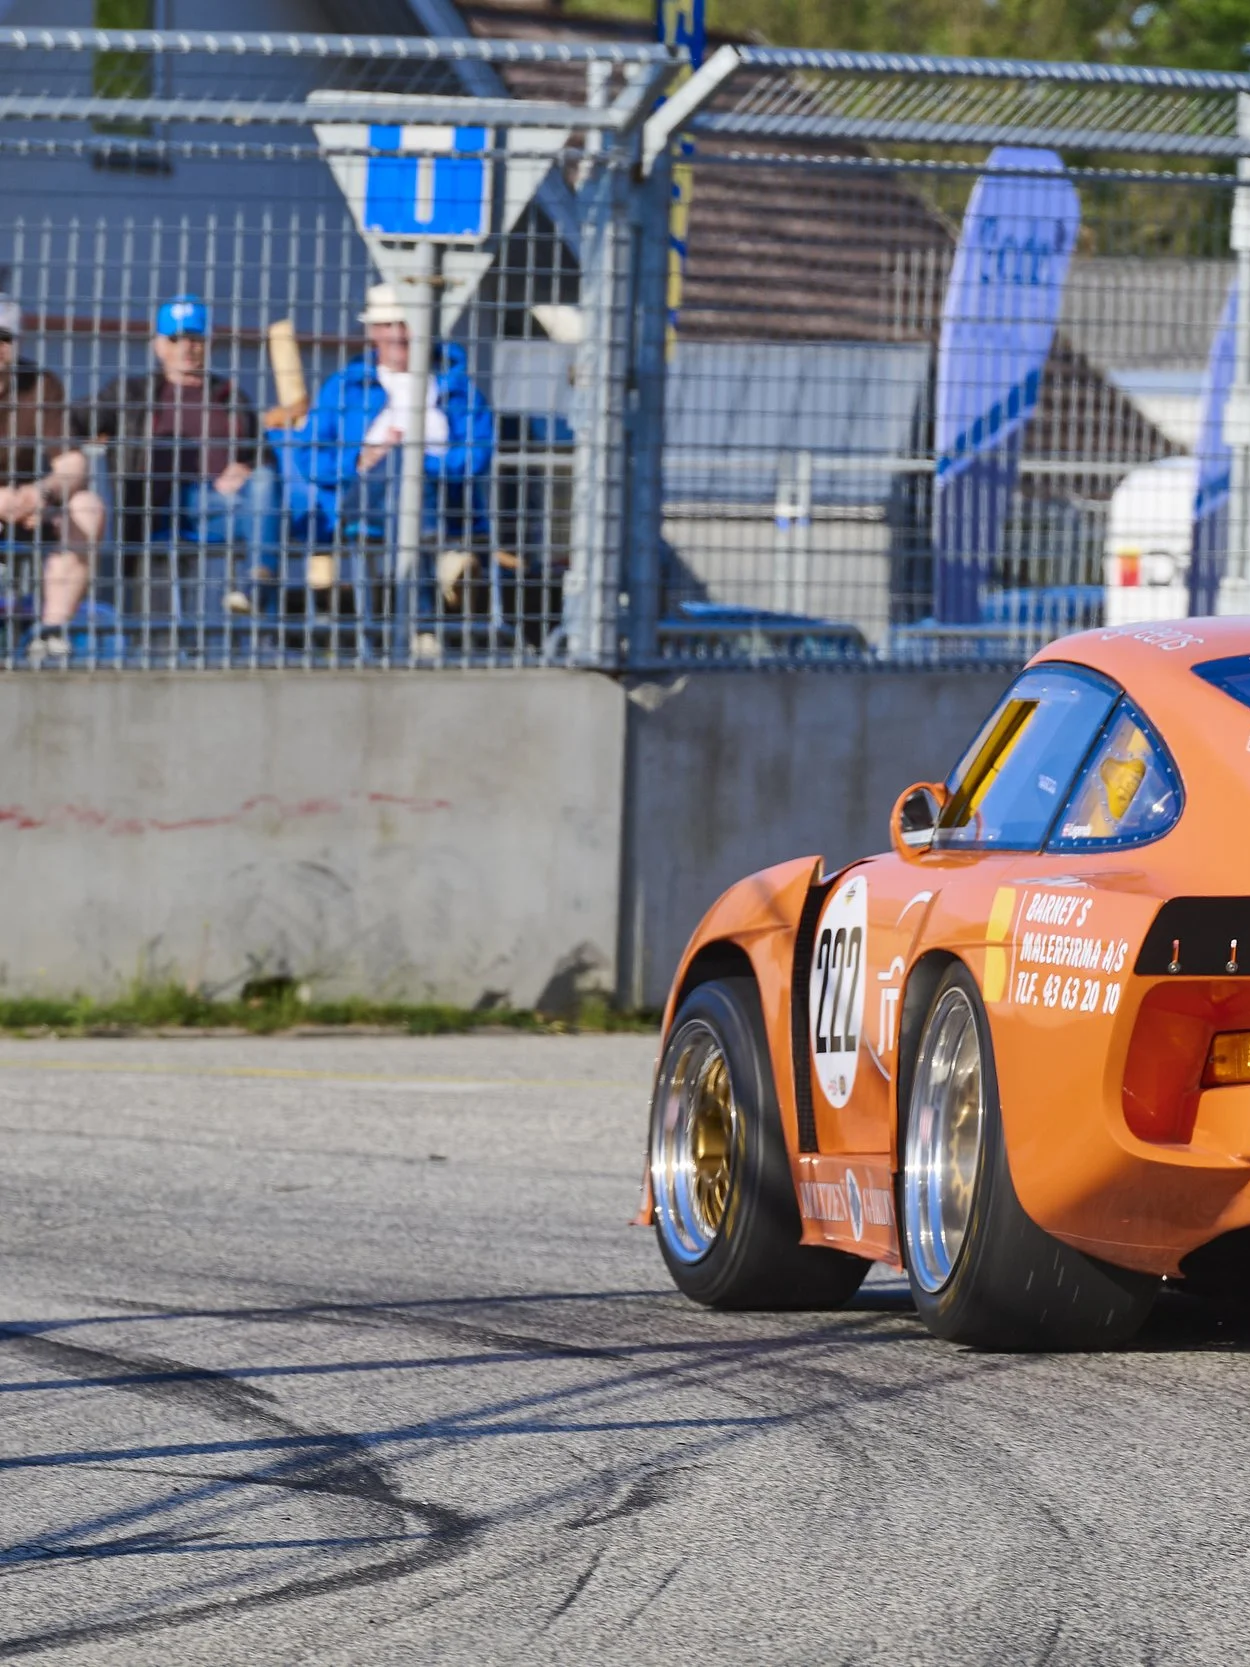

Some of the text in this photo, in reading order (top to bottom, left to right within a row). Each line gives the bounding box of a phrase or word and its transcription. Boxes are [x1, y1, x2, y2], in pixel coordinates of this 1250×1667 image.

[1020, 931, 1129, 975] MALERFIRMA A/S
[815, 926, 863, 1054] 222
[1042, 973, 1062, 1008] 43
[1061, 976, 1081, 1010] 63
[1080, 979, 1101, 1013] 20
[1102, 982, 1121, 1016] 10
